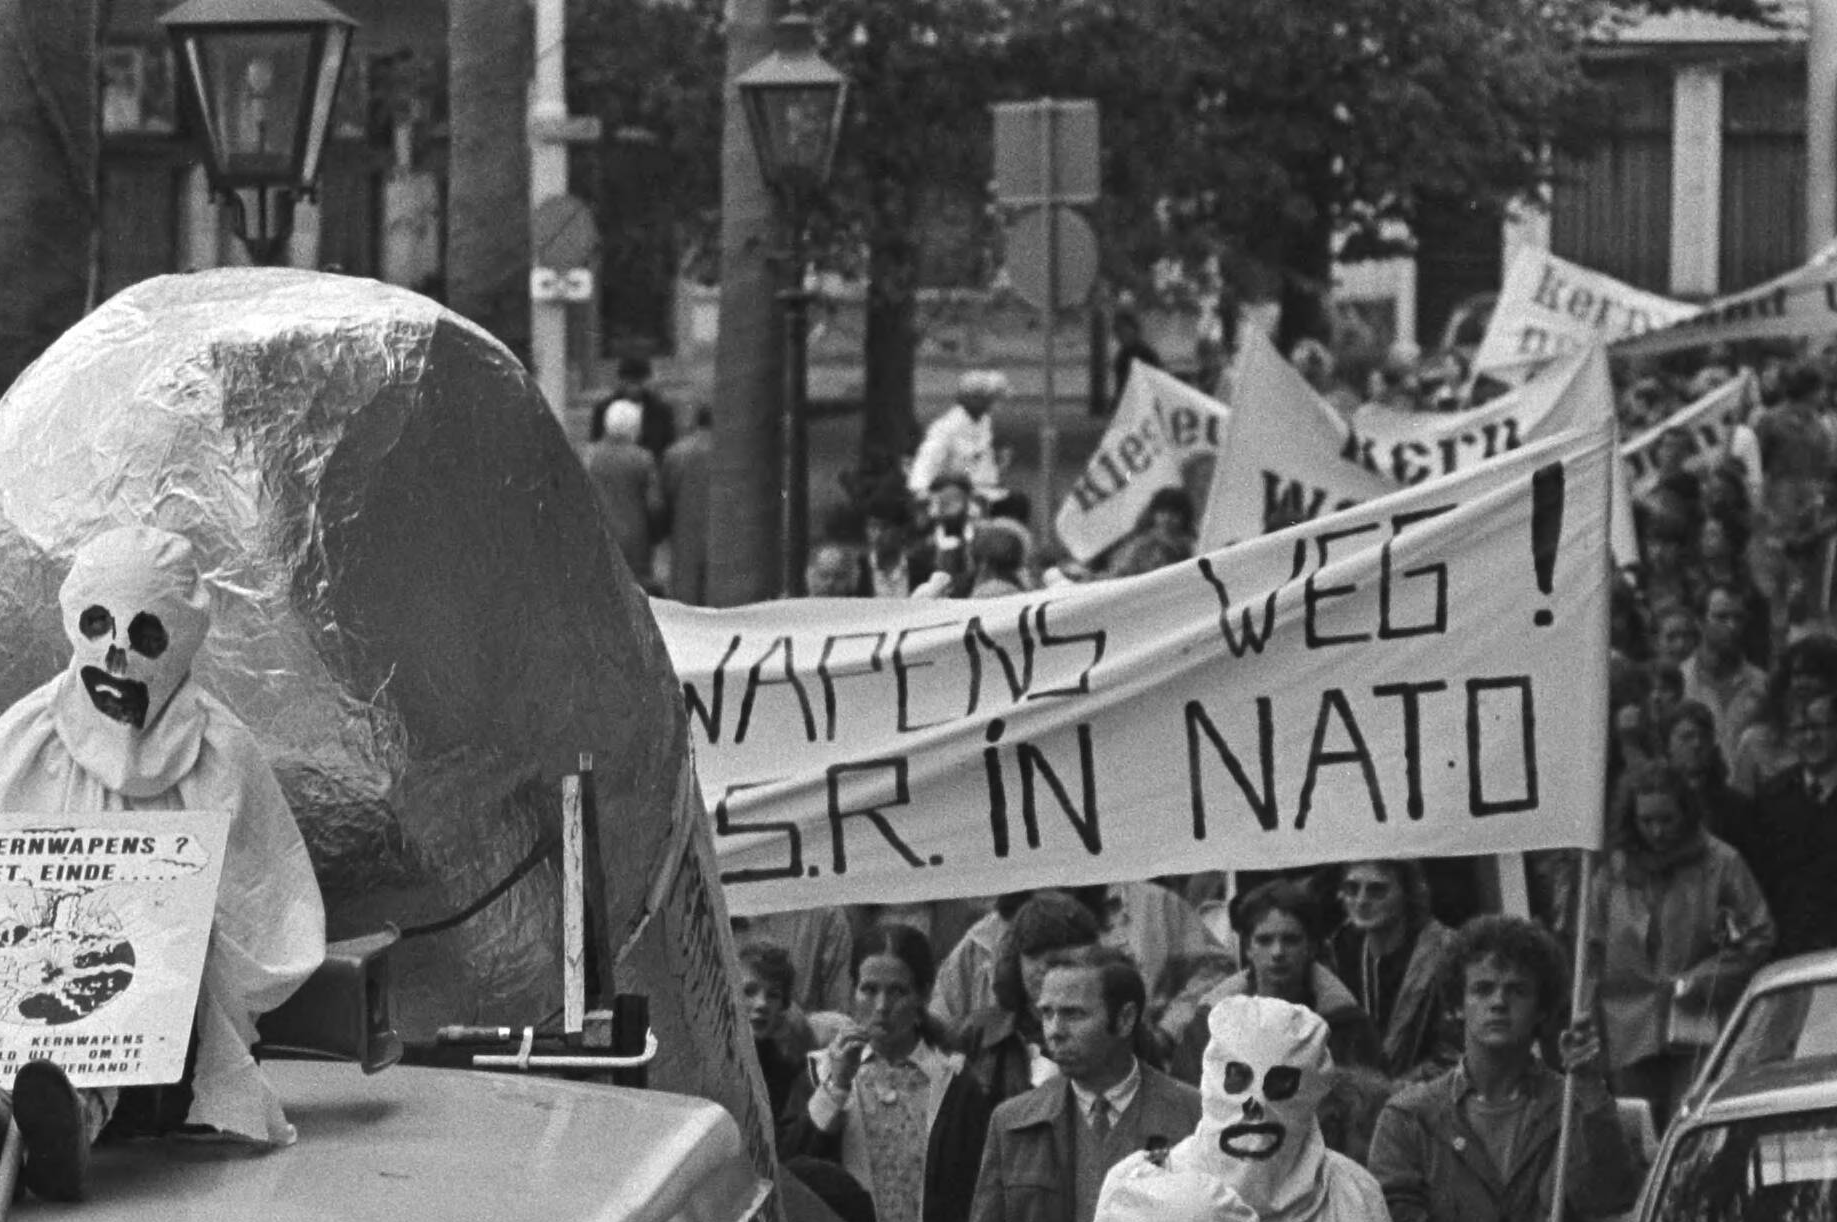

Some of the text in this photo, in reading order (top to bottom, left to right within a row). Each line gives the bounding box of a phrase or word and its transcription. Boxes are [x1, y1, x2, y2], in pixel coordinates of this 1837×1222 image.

[1197, 502, 1460, 658] WEG
[1184, 675, 1540, 841] NATO
[30, 1034, 144, 1047] KERNWAPENS
[88, 1048, 113, 1060] OM
[124, 1048, 142, 1059] TE
